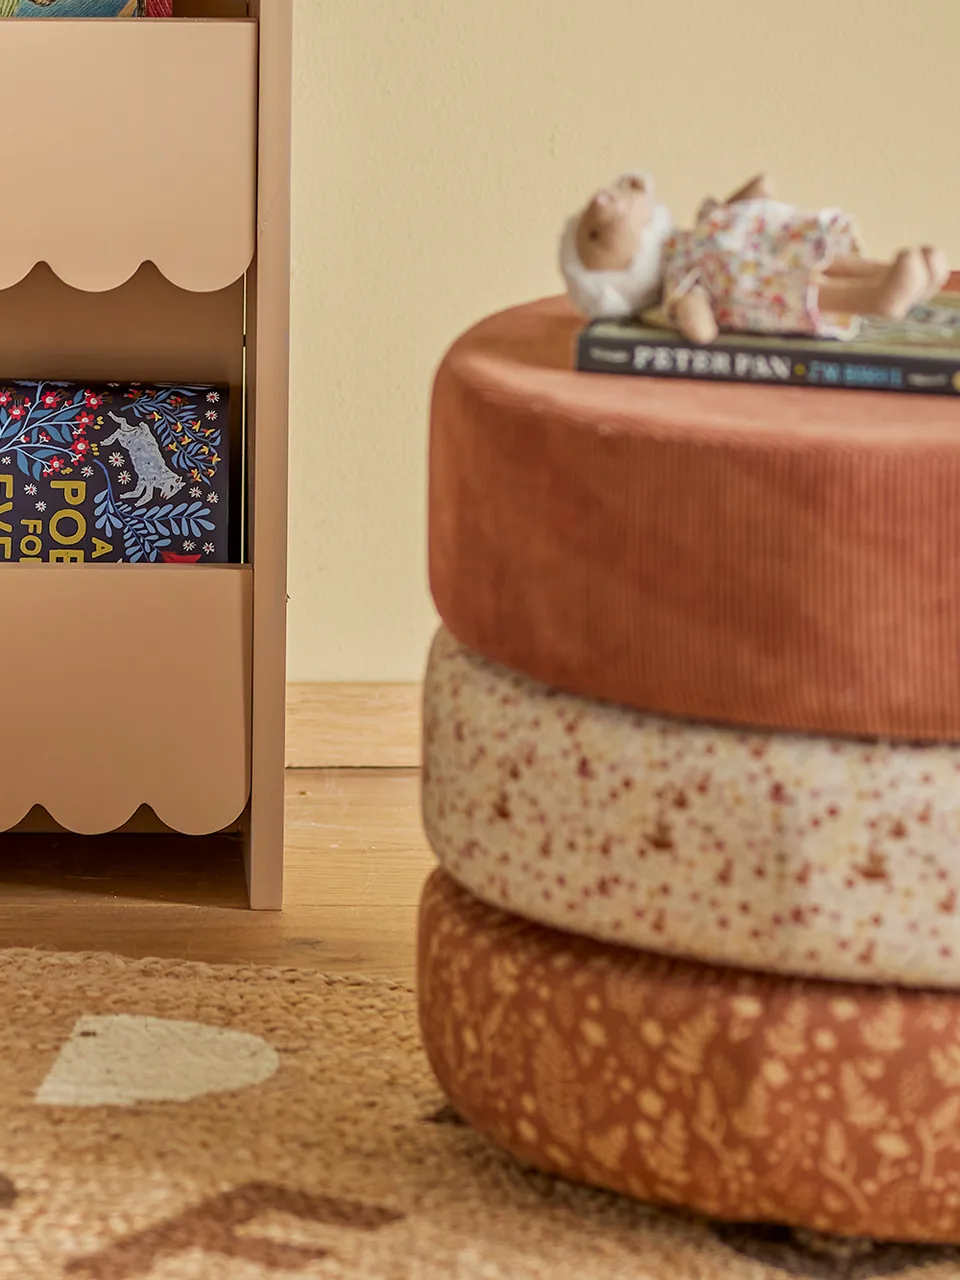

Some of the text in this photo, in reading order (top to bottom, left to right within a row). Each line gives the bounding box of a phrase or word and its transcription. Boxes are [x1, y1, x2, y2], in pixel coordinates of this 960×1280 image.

[19, 519, 43, 562] FO
[49, 480, 87, 562] POE
[91, 537, 114, 558] A
